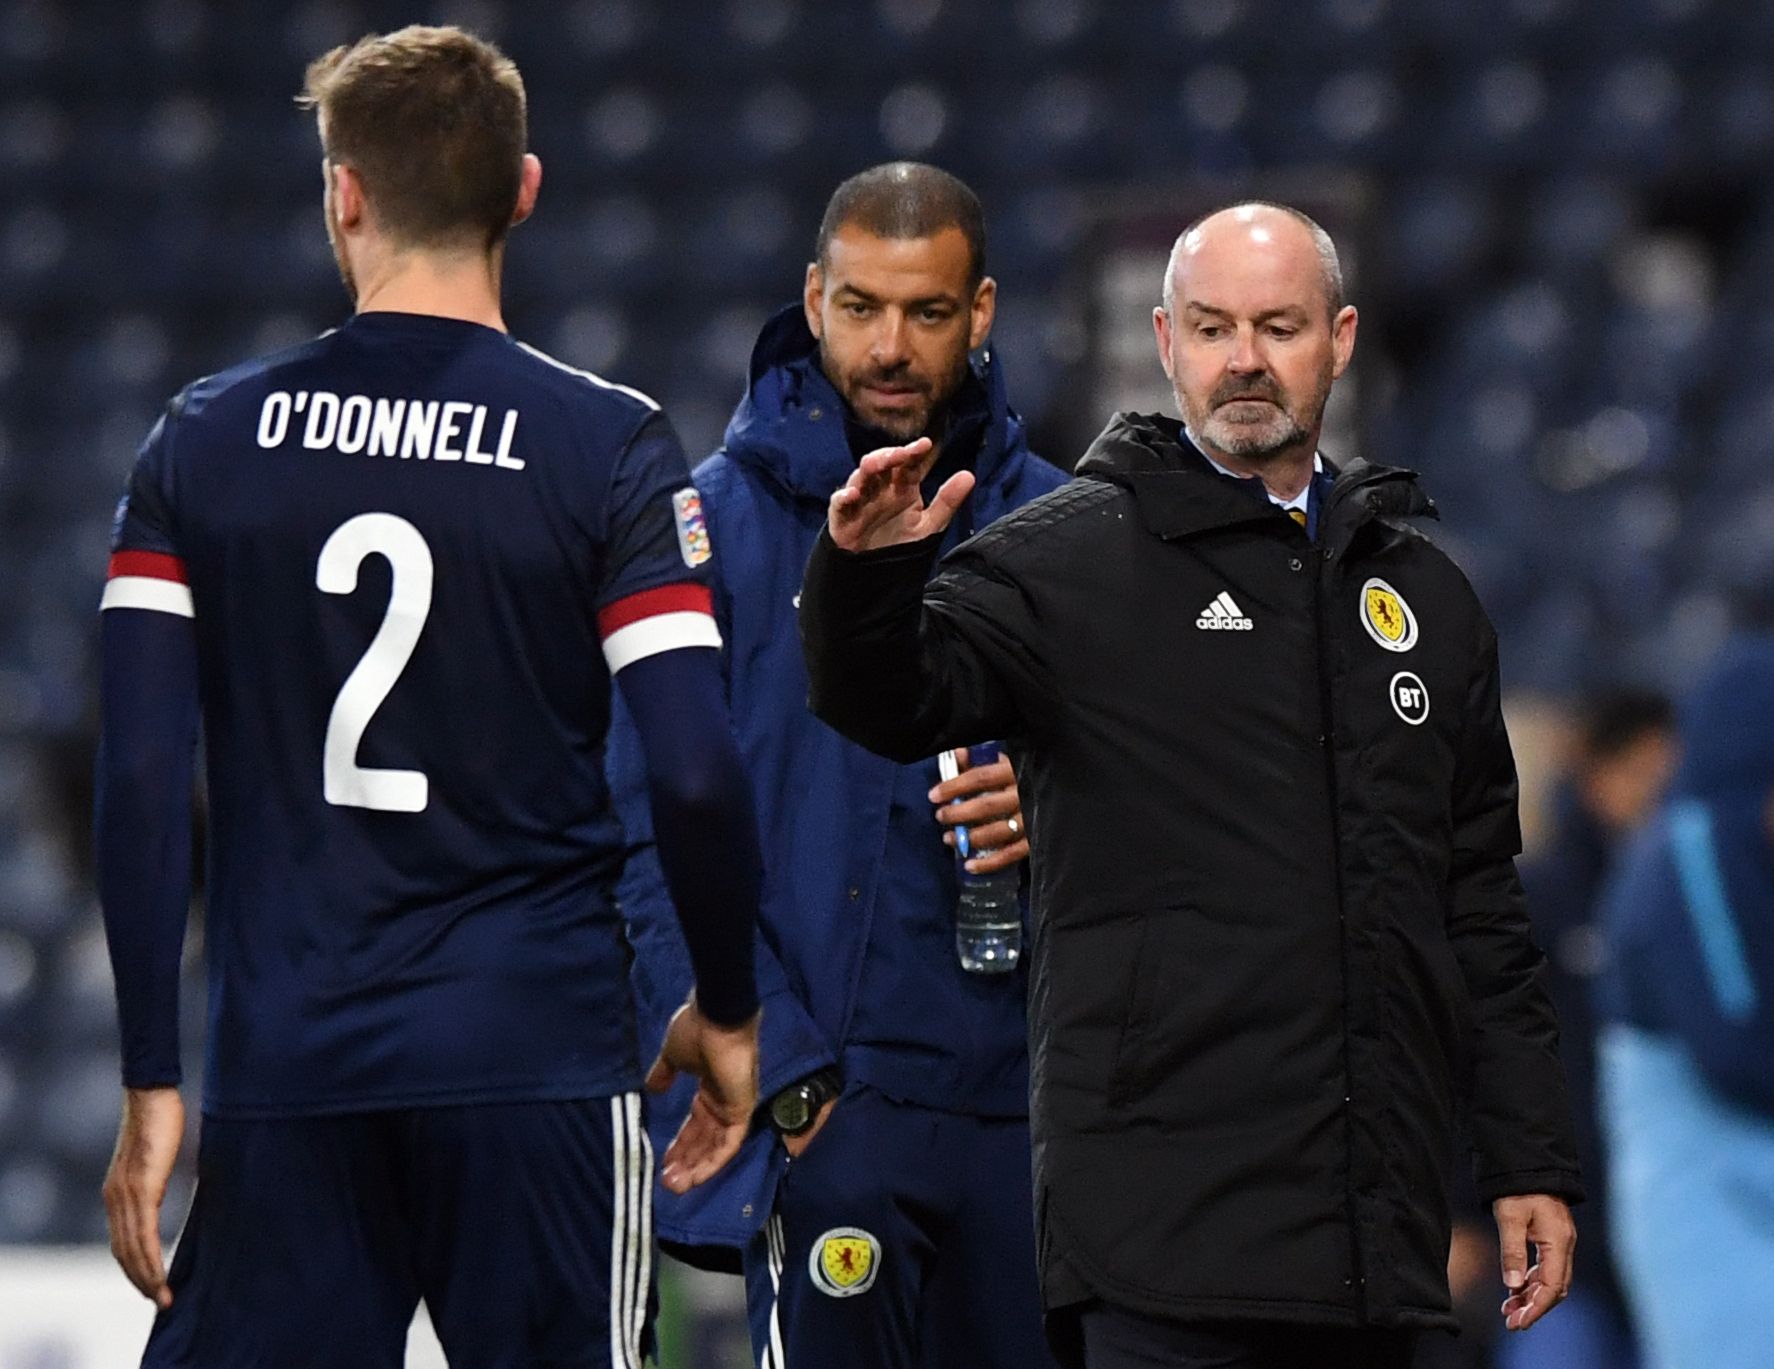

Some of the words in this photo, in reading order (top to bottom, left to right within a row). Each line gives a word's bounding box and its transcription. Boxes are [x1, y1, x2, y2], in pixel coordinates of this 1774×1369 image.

[257, 391, 526, 470] O'DONNELL
[1196, 616, 1254, 631] adidas
[316, 512, 433, 813] 2
[1398, 687, 1421, 709] BT
